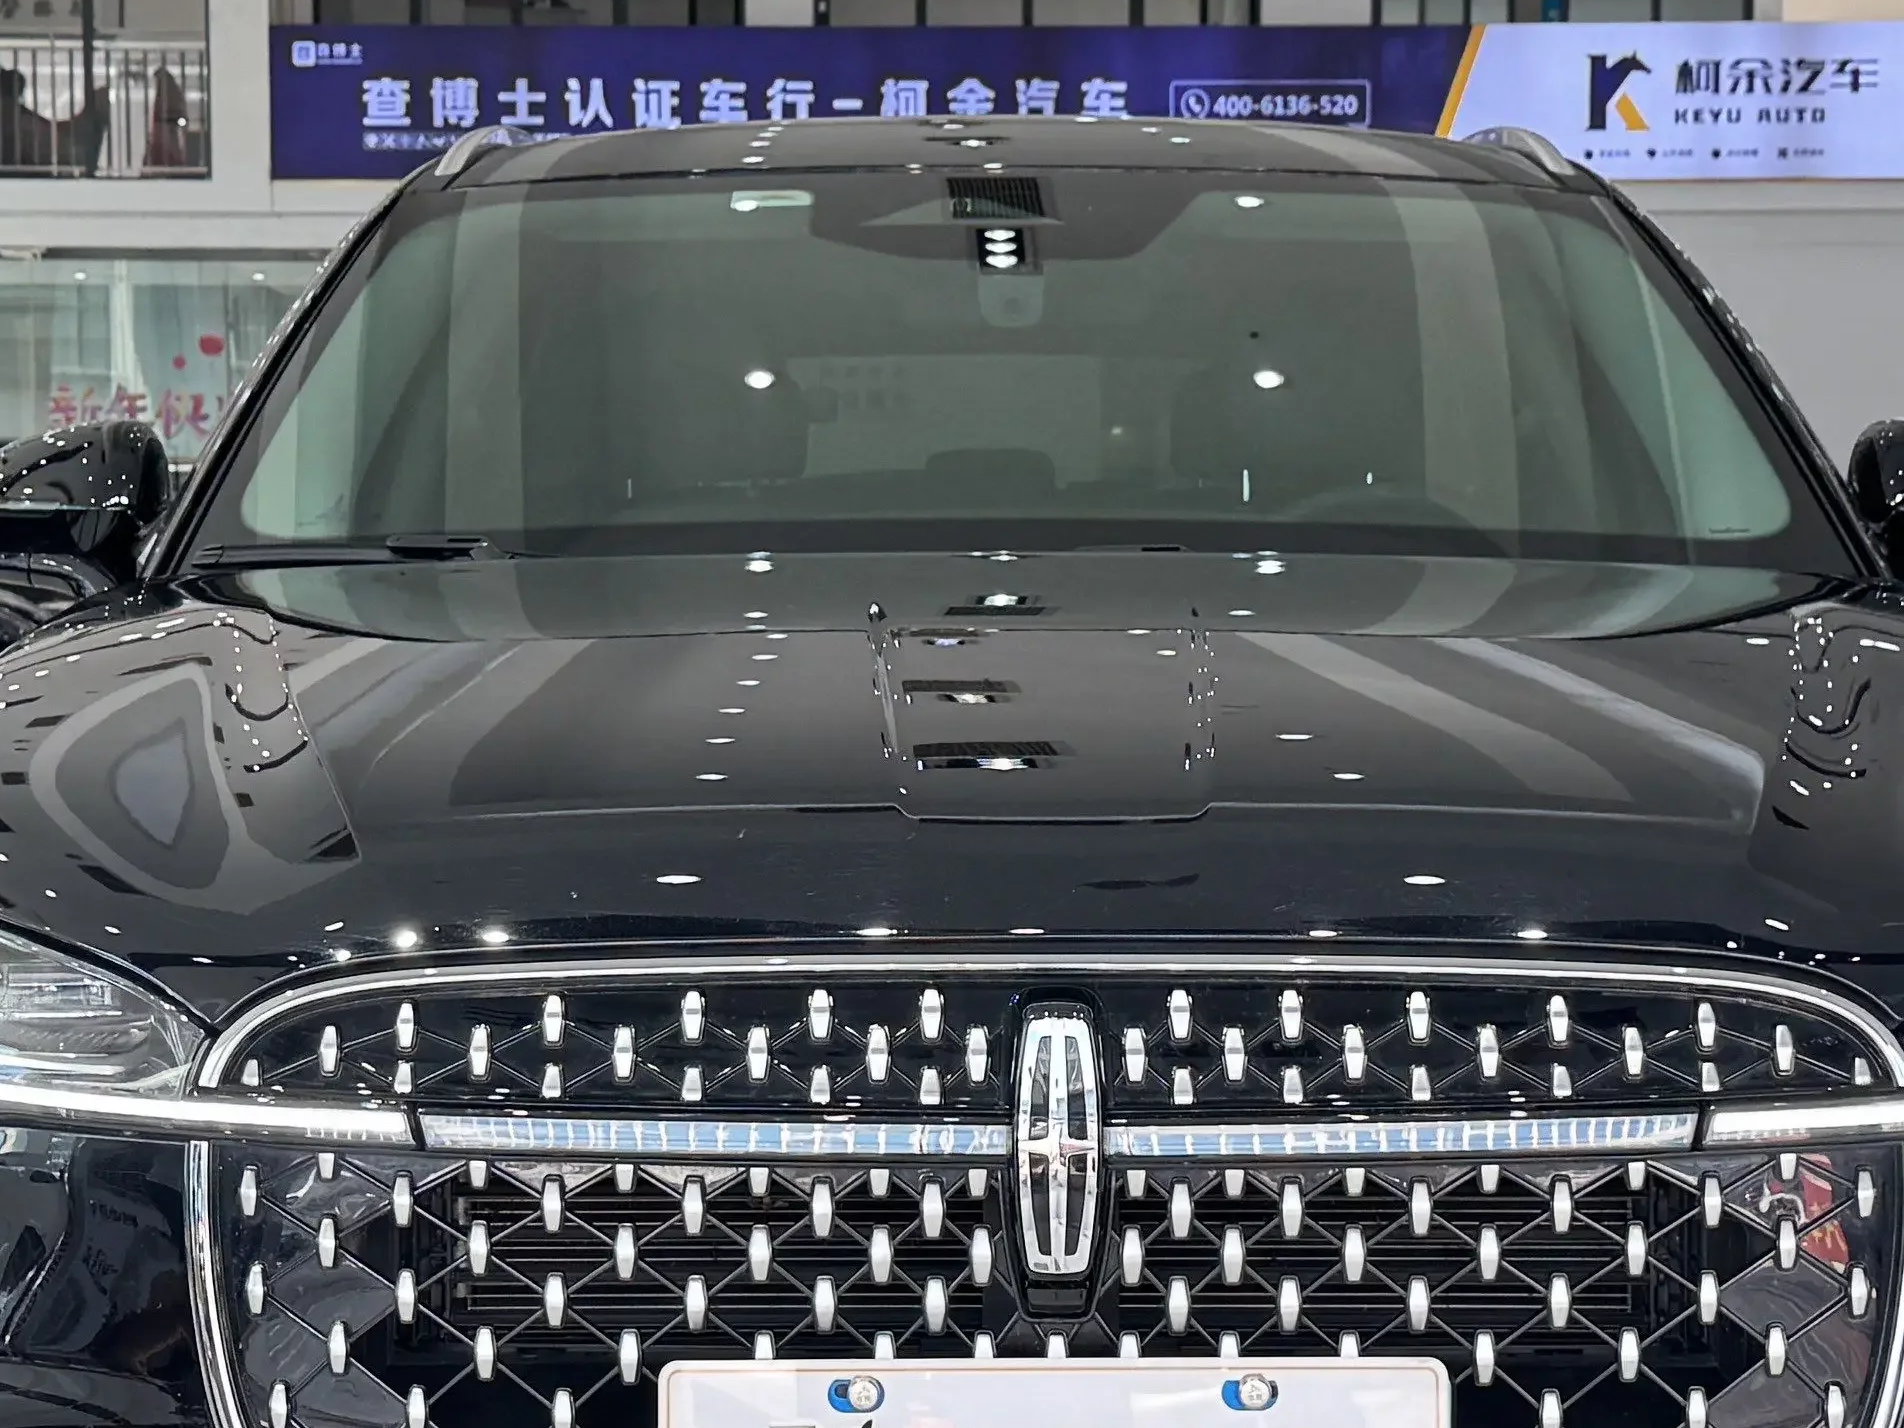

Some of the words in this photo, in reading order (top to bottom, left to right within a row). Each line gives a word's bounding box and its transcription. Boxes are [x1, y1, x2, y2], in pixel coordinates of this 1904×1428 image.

[1675, 58, 1879, 95] 柯余汽车
[1212, 94, 1360, 118] 400-6136-520
[1673, 106, 1742, 125] KEYU
[1757, 106, 1827, 125] AUTO
[49, 383, 226, 441] 新年快
